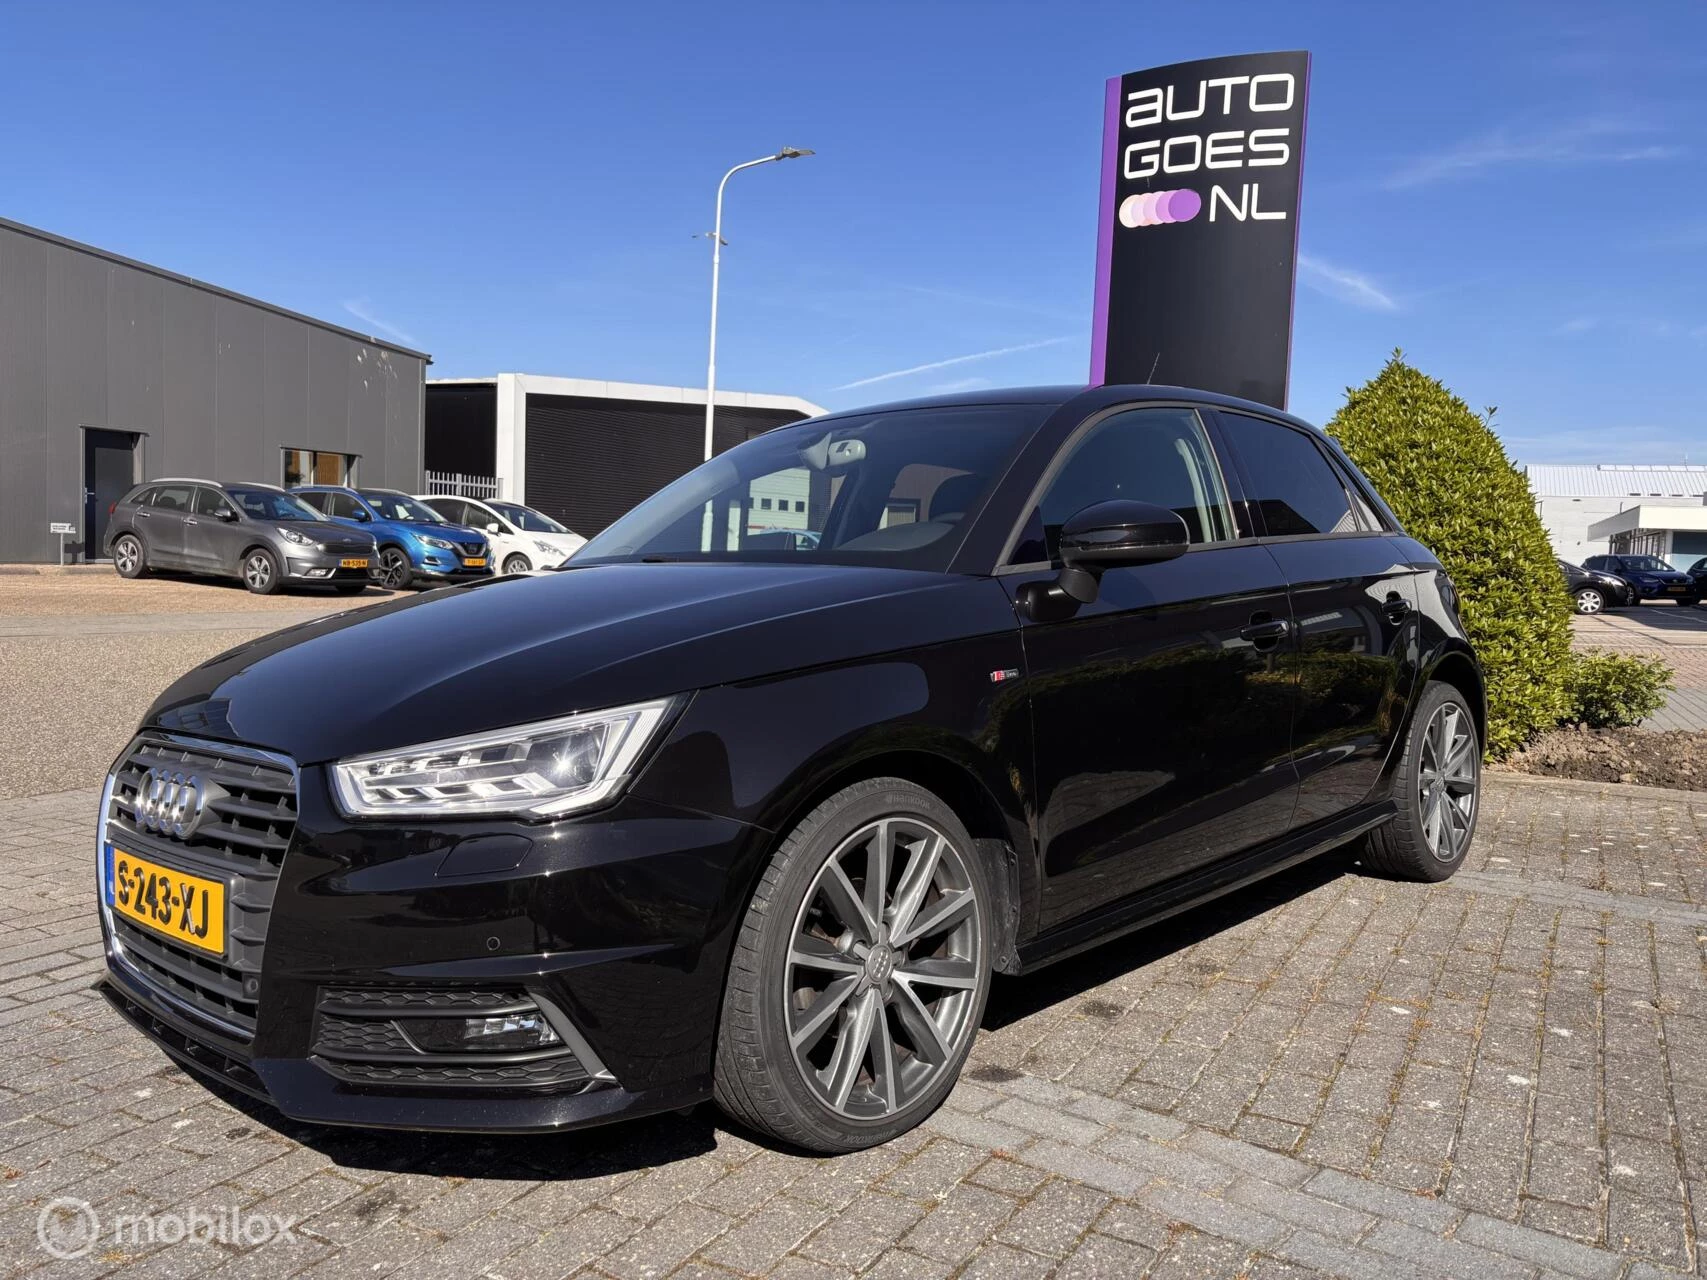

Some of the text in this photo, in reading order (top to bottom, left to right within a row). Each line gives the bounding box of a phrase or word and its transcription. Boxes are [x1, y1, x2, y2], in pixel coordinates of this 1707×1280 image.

[1123, 128, 1290, 179] GOES
[1209, 183, 1287, 222] NL
[118, 860, 209, 939] S-243-XJ
